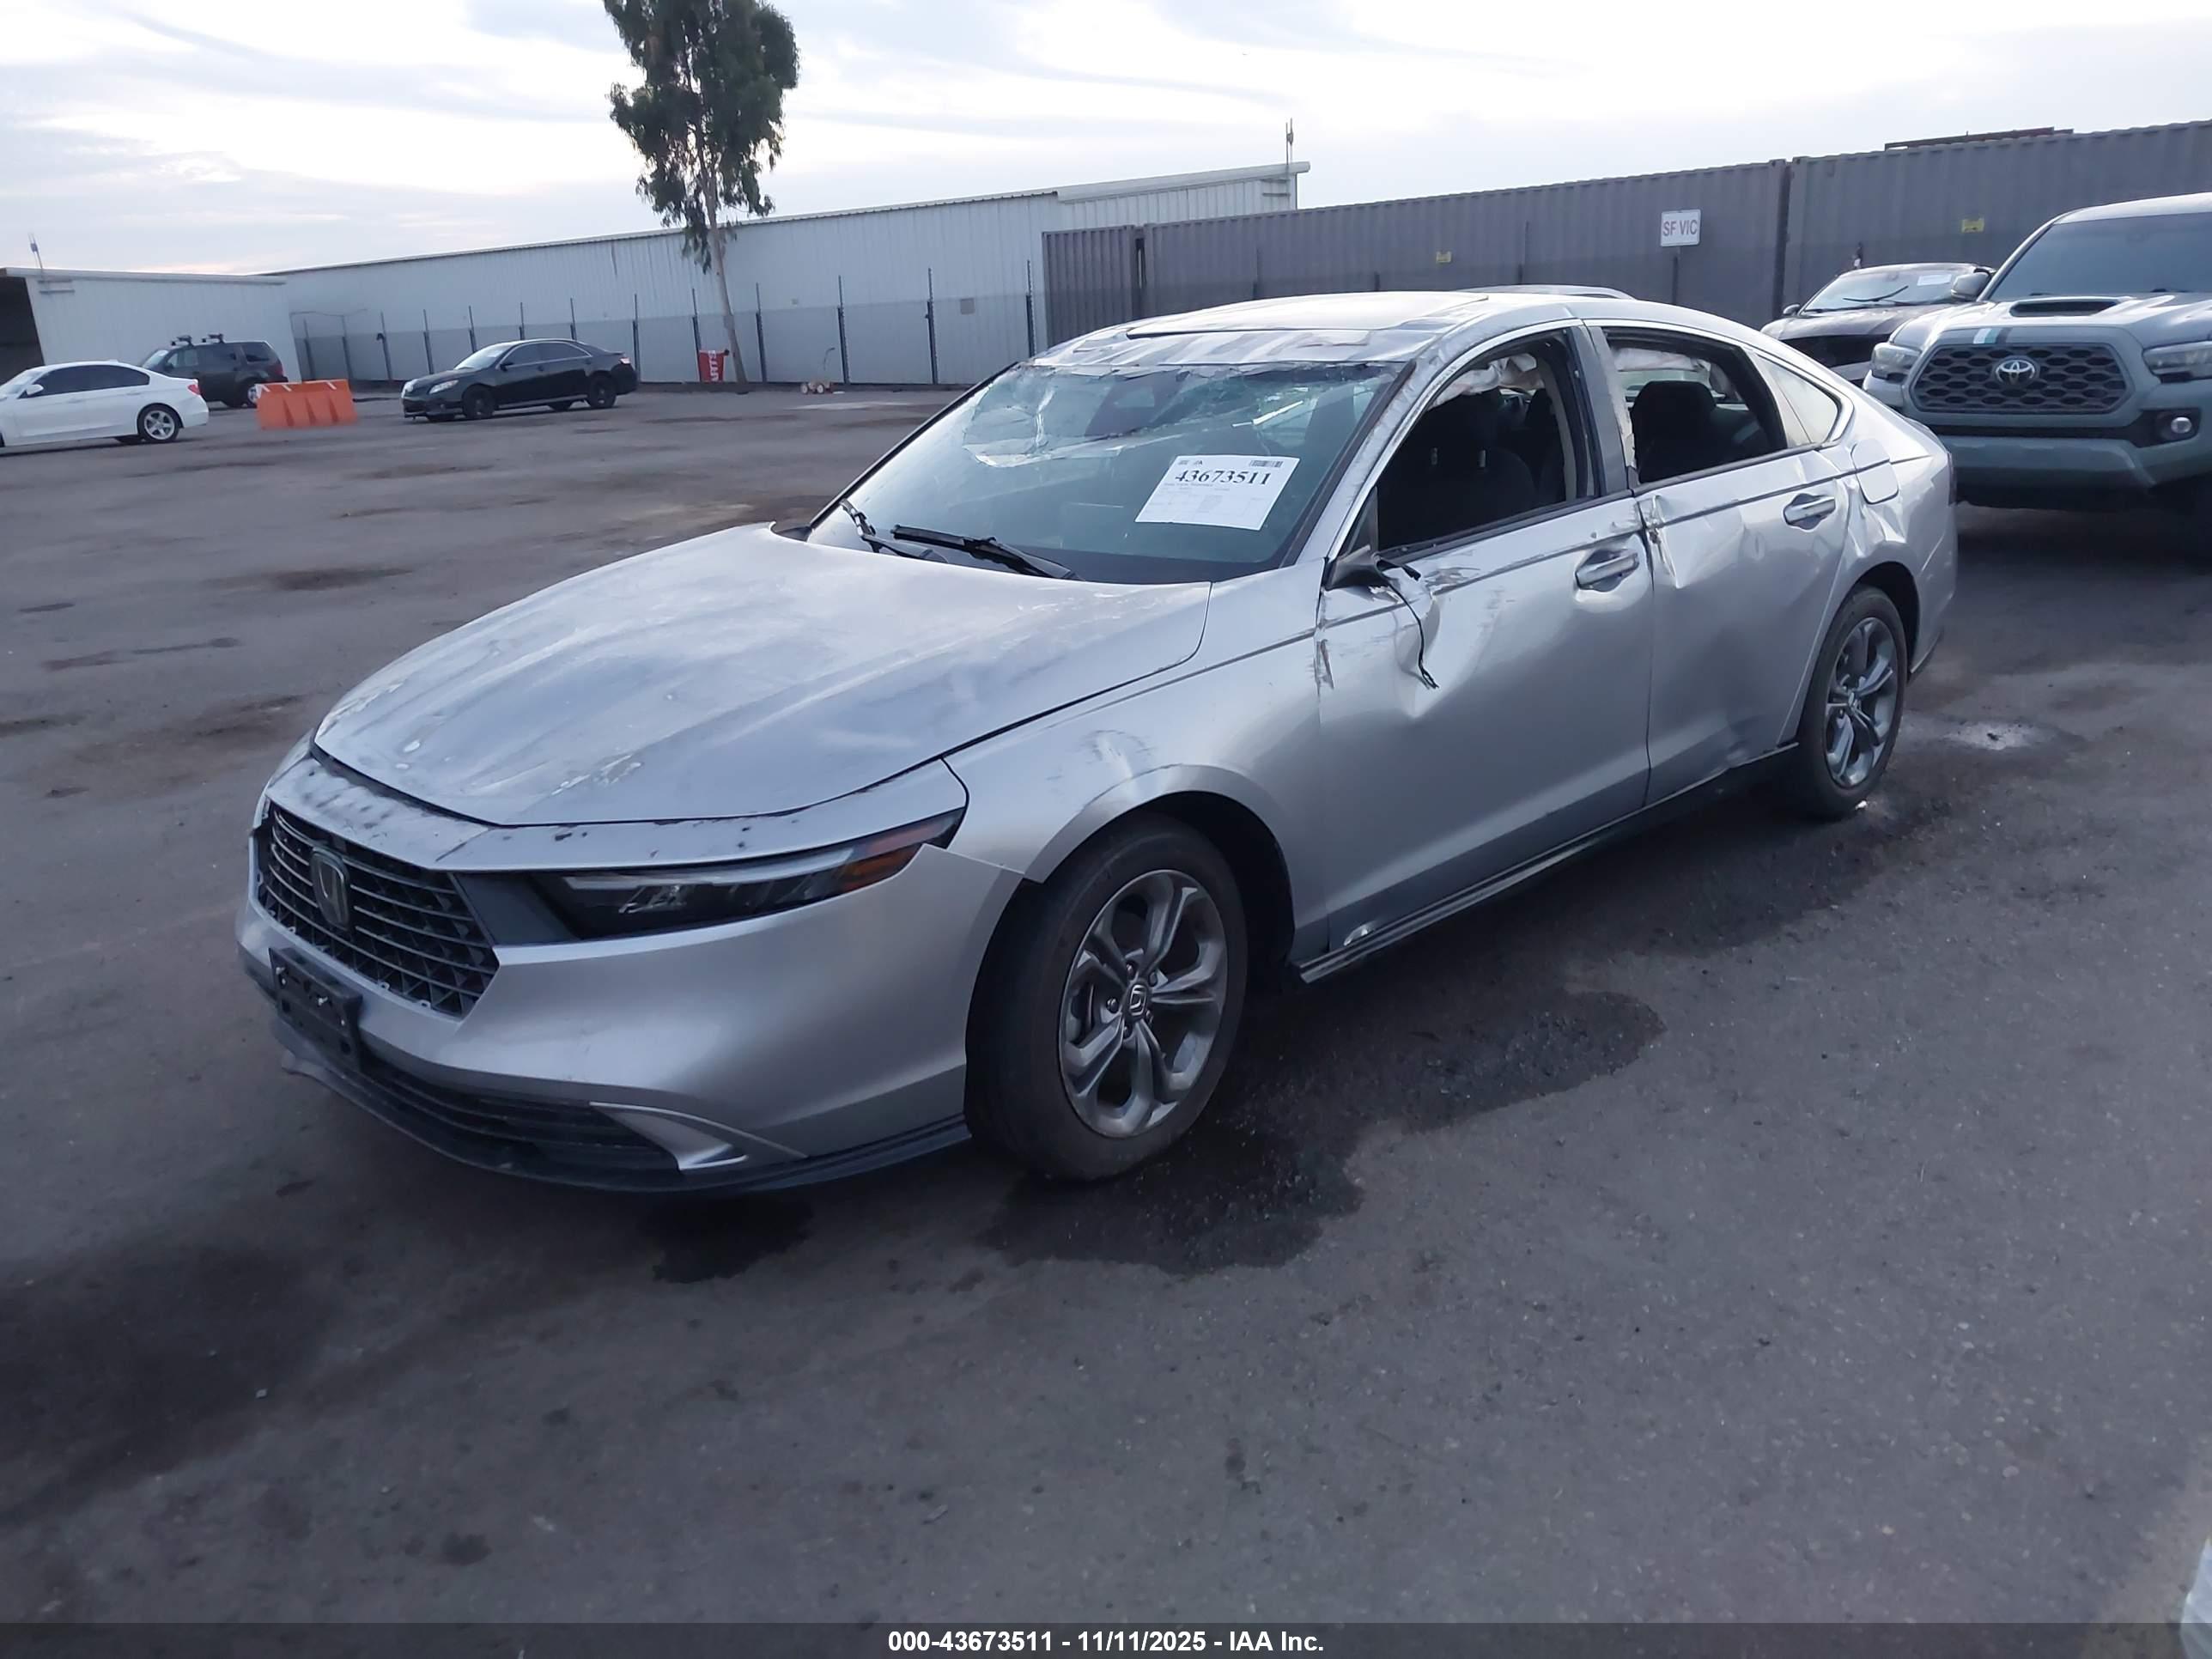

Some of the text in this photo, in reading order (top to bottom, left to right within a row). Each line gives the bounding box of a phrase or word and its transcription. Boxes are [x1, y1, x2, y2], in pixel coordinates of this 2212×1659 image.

[1662, 219, 1698, 237] SF VIC
[1175, 469, 1272, 485] 43673511
